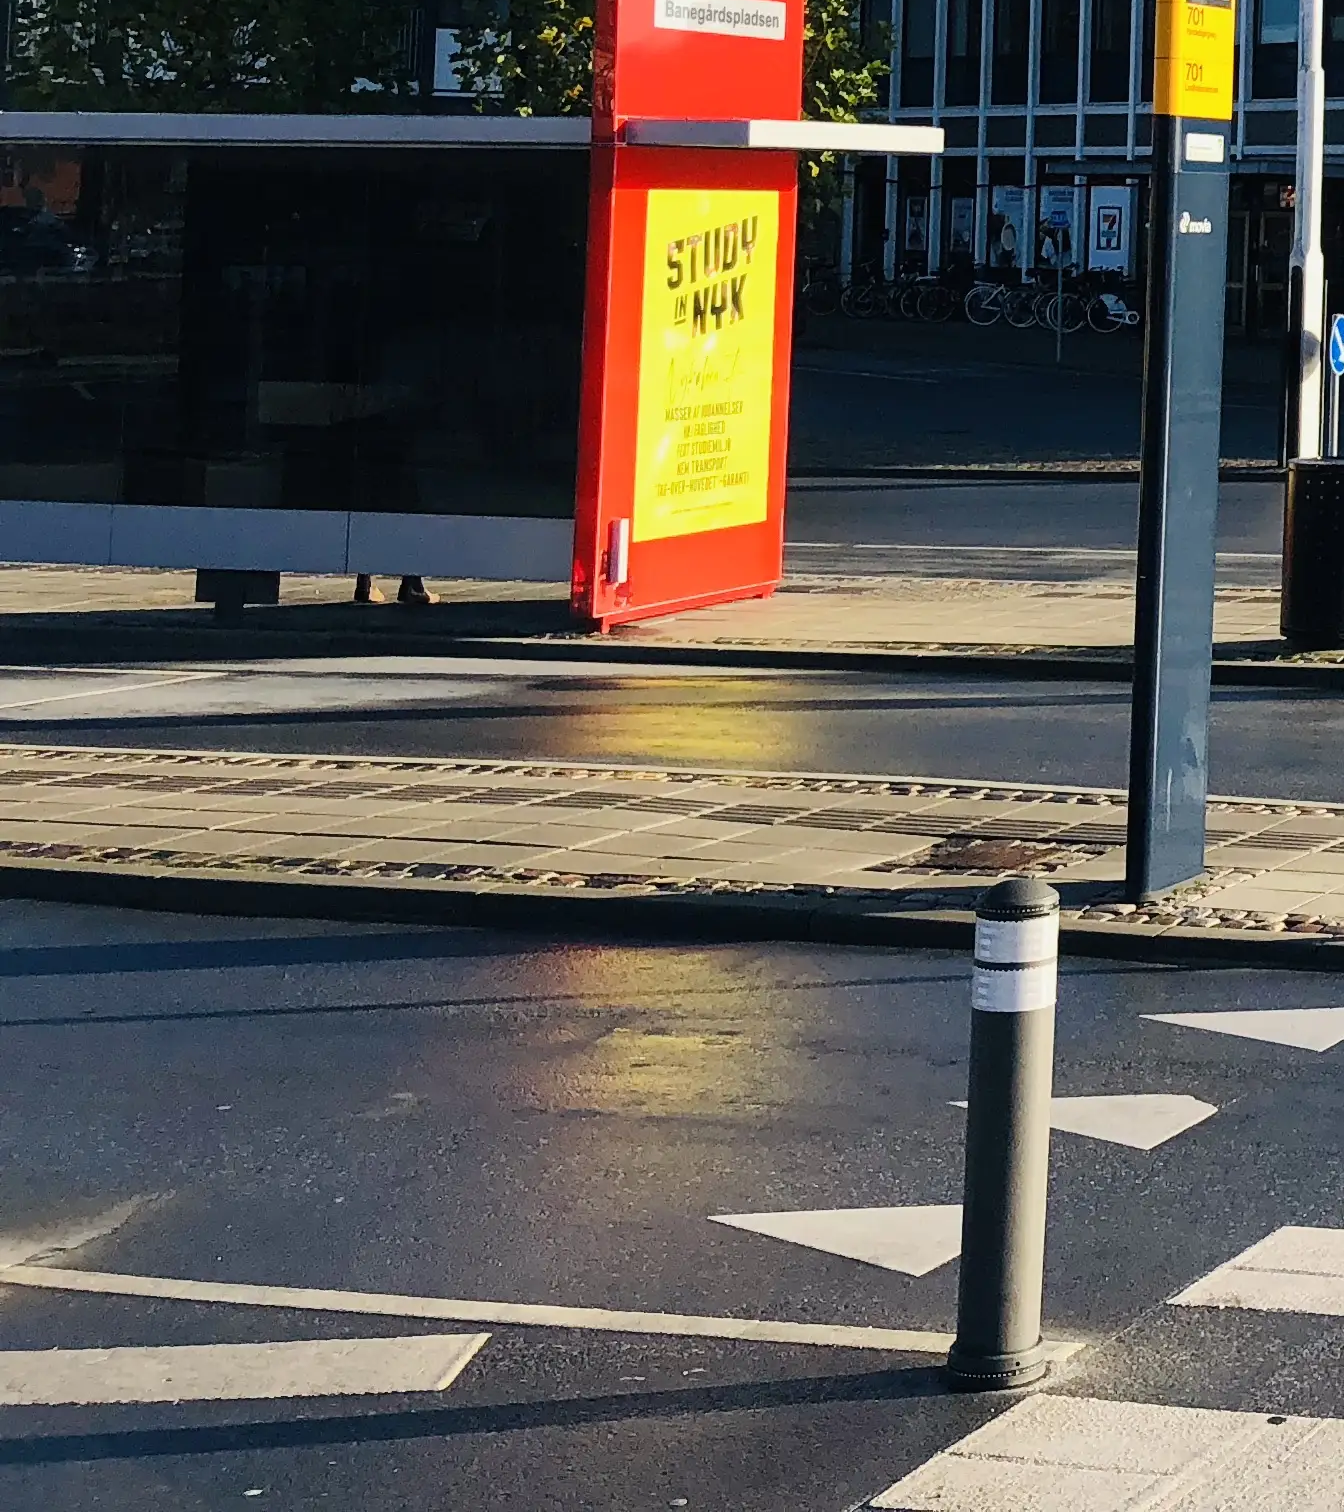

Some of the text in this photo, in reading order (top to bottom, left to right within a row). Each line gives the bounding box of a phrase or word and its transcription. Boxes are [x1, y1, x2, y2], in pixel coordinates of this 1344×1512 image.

[665, 0, 779, 28] Banegårdspladsen
[1187, 7, 1205, 26] 701
[1185, 62, 1203, 82] 701
[667, 215, 758, 291] STUDY
[674, 273, 748, 339] IN NYK
[664, 406, 692, 422] MASSER
